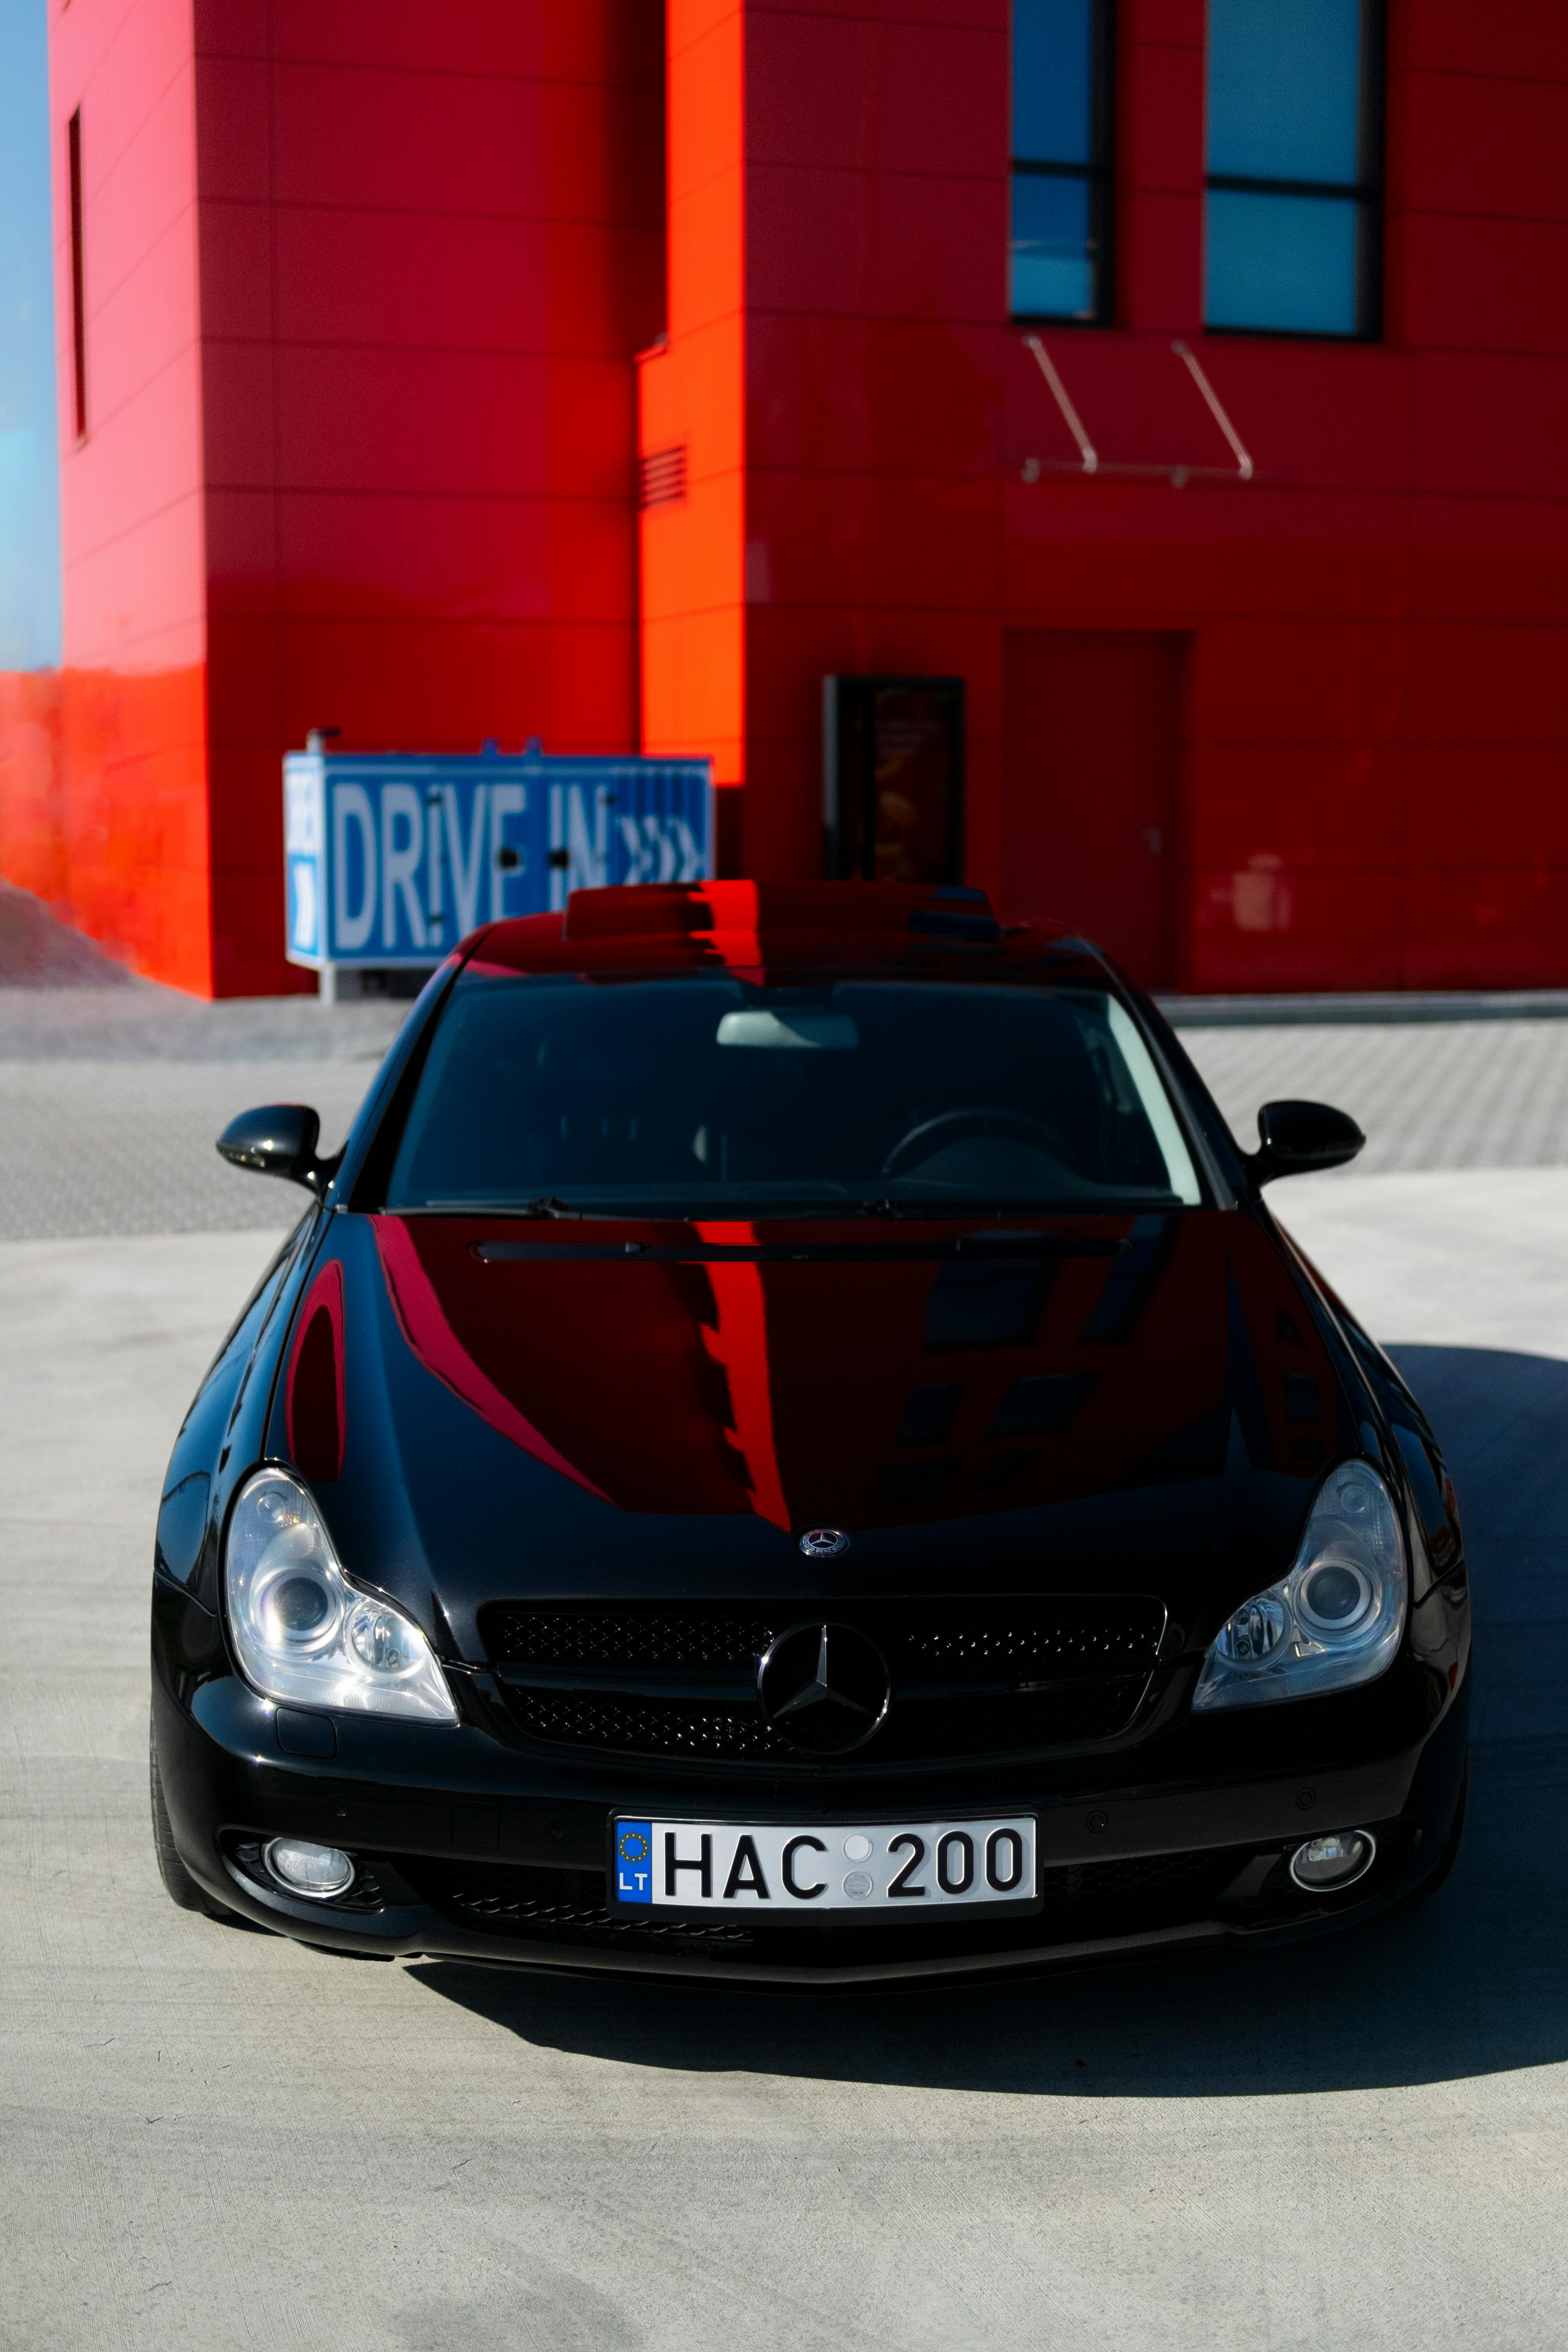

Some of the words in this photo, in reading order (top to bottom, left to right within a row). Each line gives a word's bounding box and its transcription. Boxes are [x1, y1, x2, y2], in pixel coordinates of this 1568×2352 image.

[332, 782, 526, 950] DRIVE
[549, 783, 608, 916] IN
[619, 1872, 648, 1891] LT
[664, 1833, 829, 1899] HAC
[886, 1827, 1024, 1898] 200
